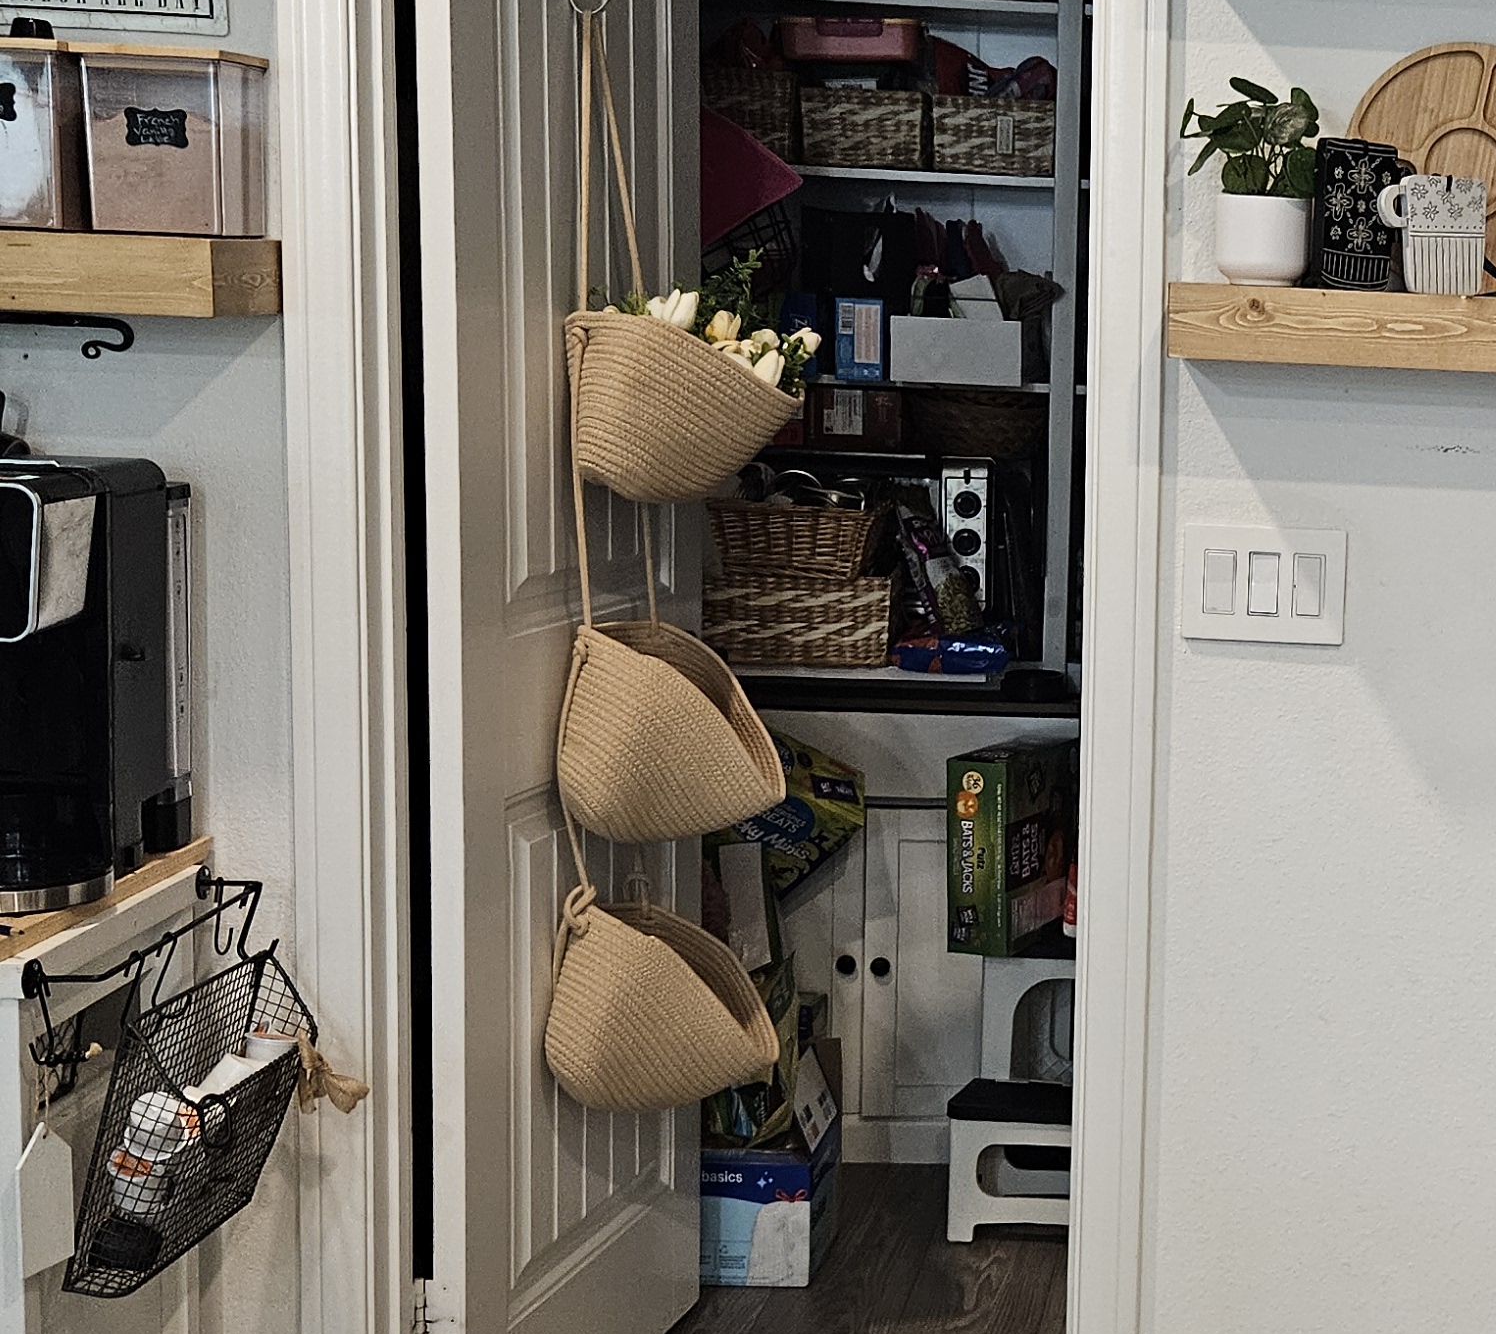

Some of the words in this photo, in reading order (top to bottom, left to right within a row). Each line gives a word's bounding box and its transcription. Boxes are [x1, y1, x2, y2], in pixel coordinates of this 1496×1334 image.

[136, 113, 180, 126] French
[972, 776, 982, 790] 36
[960, 820, 973, 848] BATS
[762, 833, 810, 859] Minis
[963, 849, 973, 857] &
[960, 858, 973, 894] JACKS
[702, 1170, 743, 1183] basics
